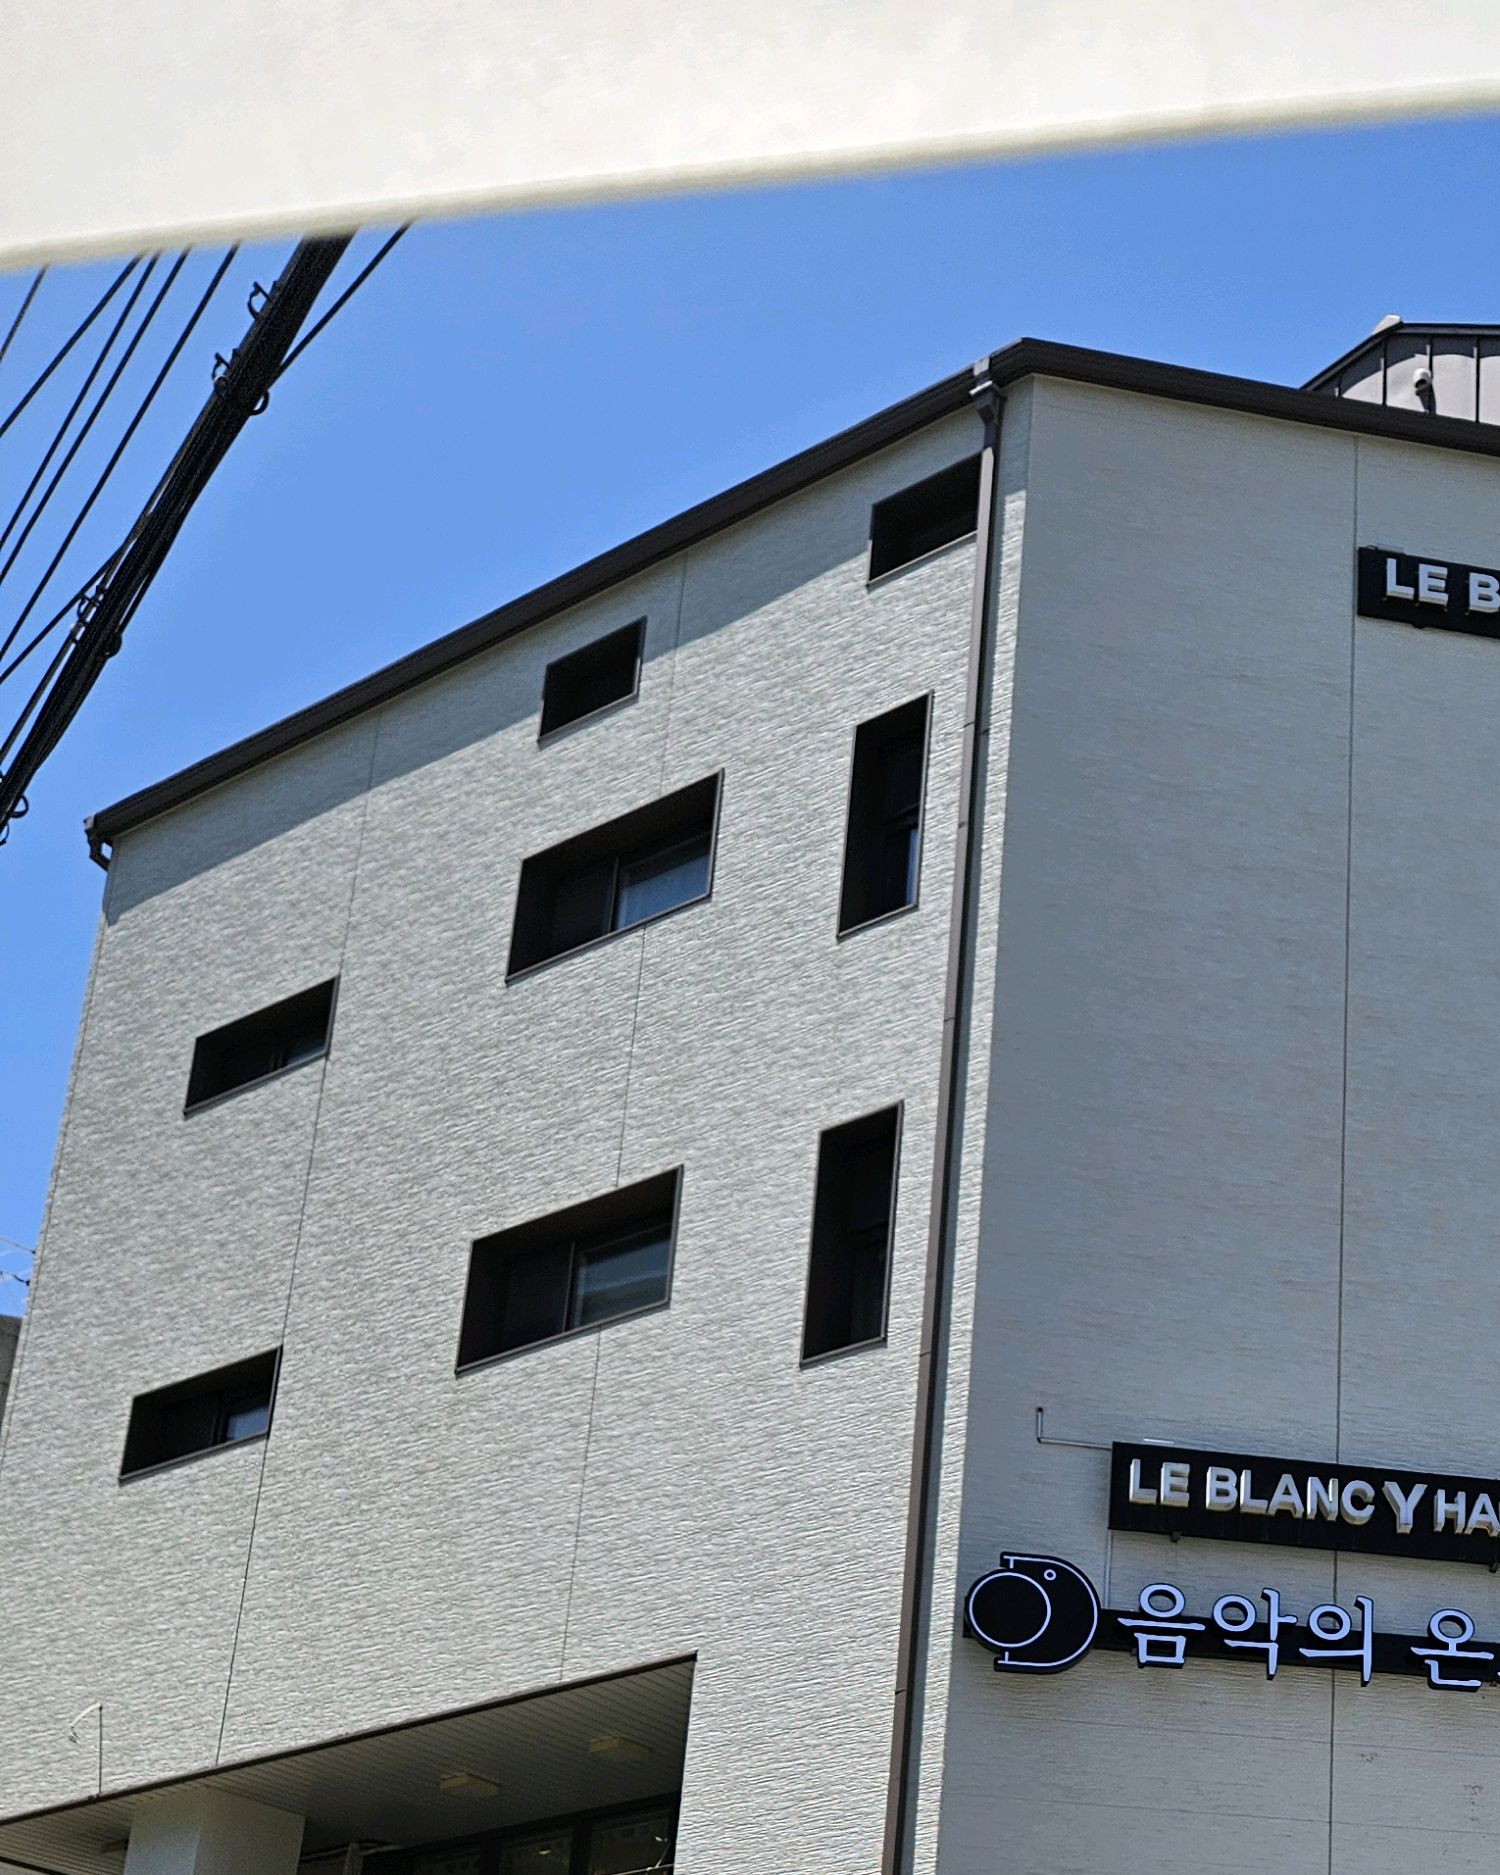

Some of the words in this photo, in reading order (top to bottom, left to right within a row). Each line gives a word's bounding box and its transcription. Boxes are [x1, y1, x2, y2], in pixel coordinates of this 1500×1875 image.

[1386, 557, 1449, 605] LE
[1129, 1458, 1191, 1508] LE
[1206, 1466, 1375, 1526] BLANC
[1117, 1582, 1374, 1684] 음악의
